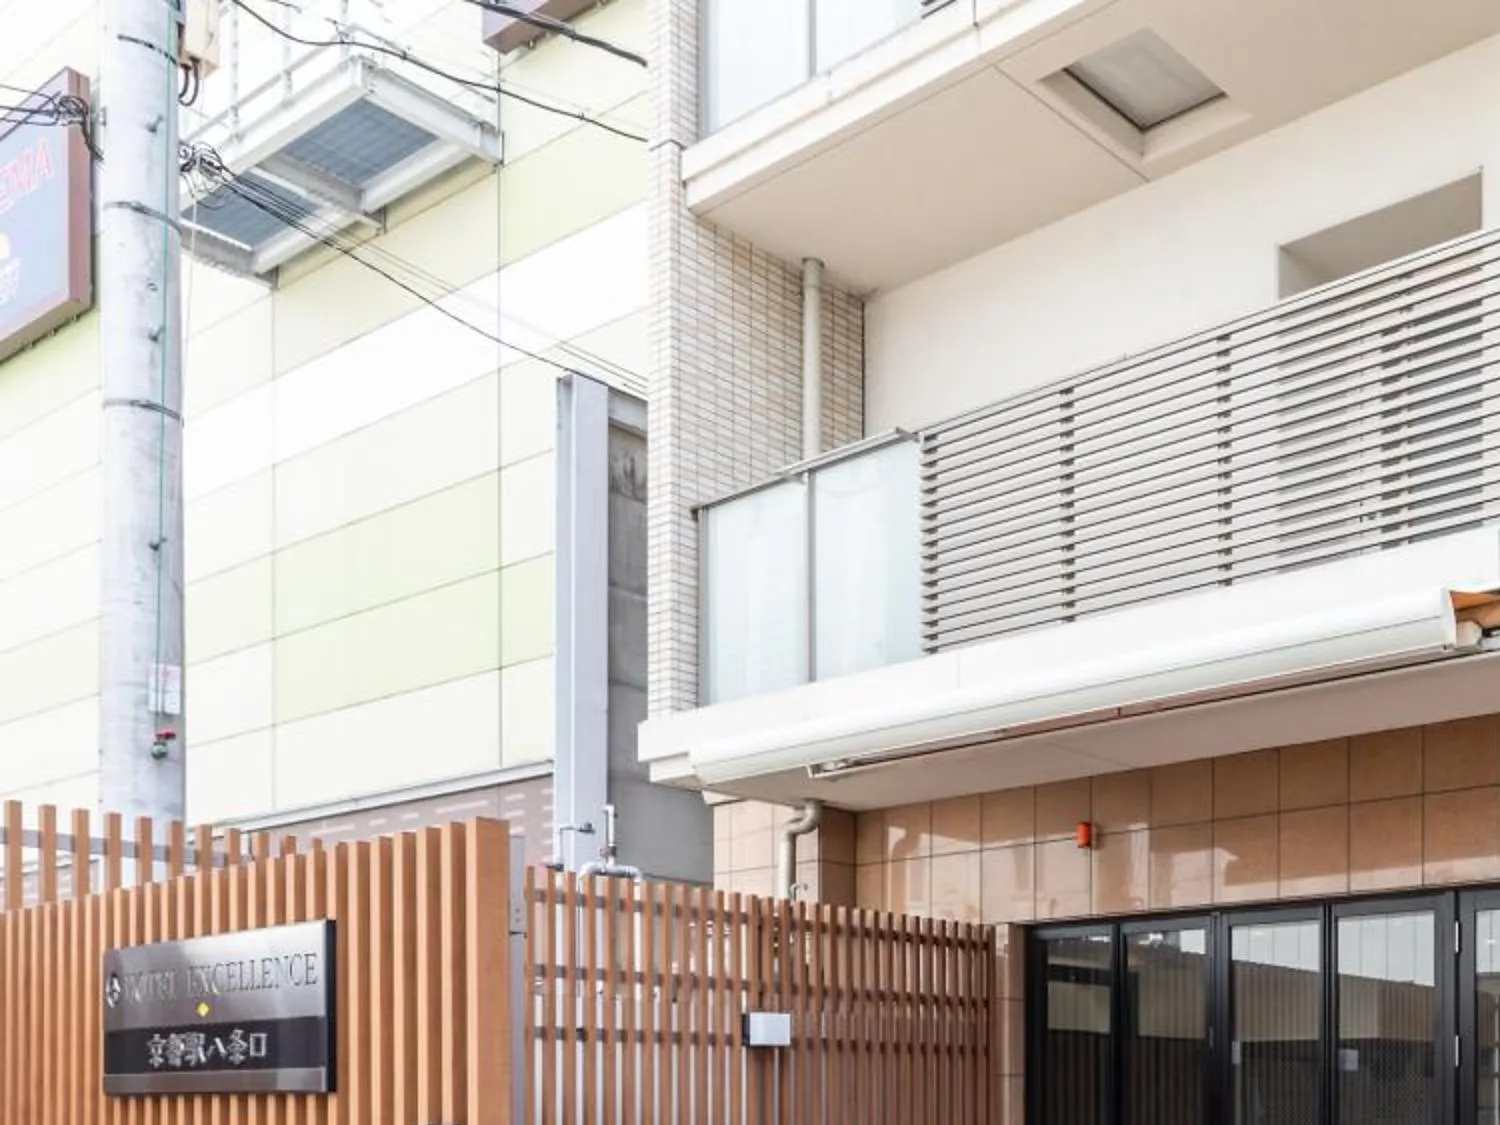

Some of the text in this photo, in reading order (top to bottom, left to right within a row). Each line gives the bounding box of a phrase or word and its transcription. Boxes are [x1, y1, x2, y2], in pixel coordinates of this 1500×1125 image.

[186, 952, 318, 997] EXCELLENCE
[146, 1028, 268, 1069] 京都駅八条口
